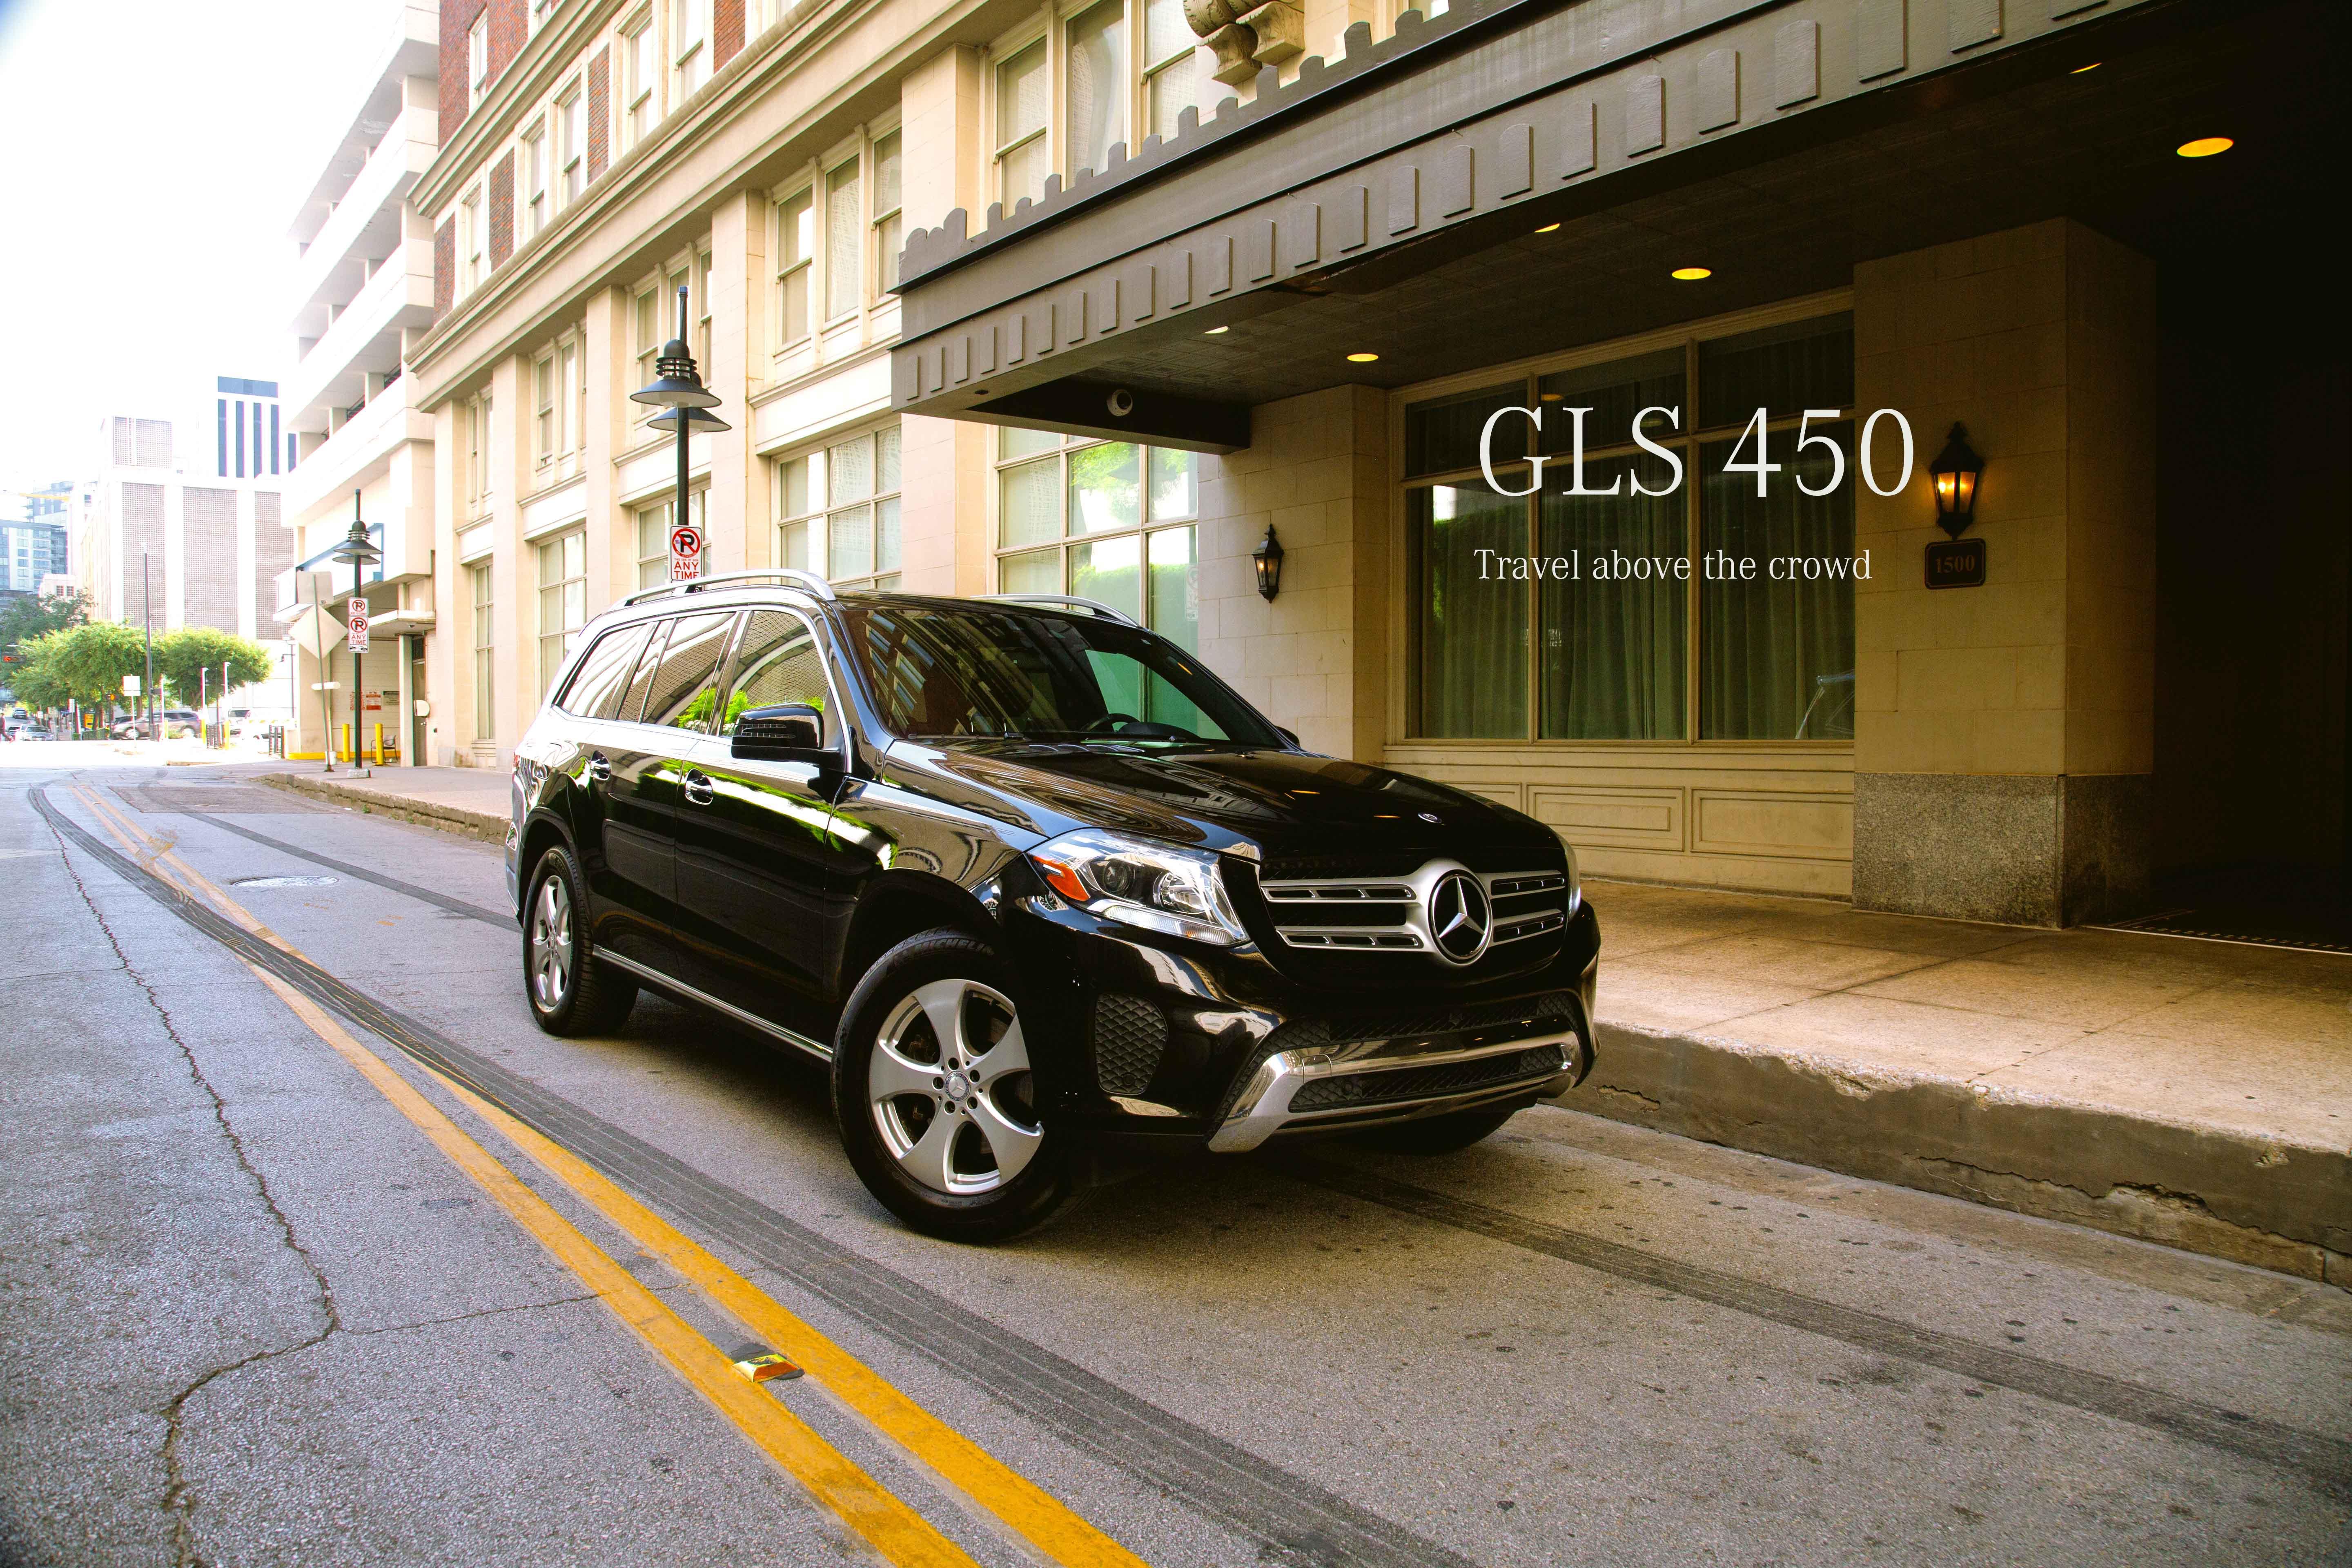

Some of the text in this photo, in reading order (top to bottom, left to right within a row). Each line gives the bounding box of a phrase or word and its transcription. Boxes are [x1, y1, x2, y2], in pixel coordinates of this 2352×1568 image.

[674, 561, 699, 570] ANY
[1934, 555, 1975, 573] 1500
[674, 570, 699, 579] TIME
